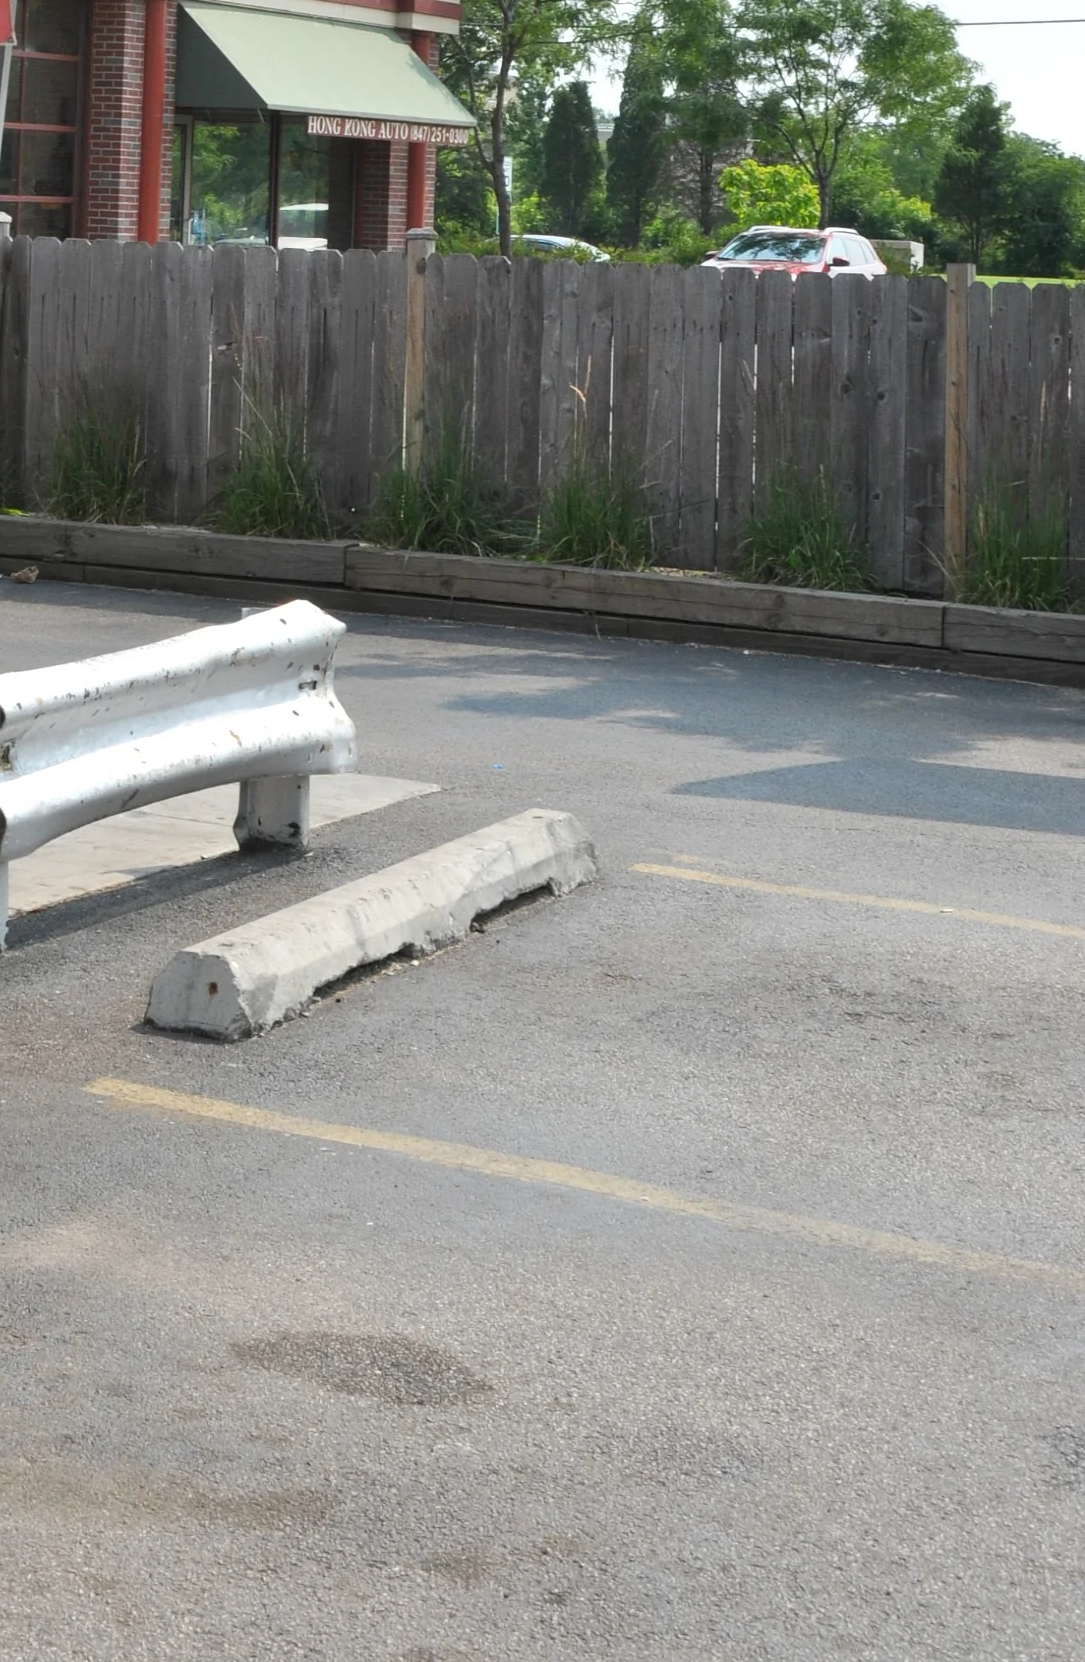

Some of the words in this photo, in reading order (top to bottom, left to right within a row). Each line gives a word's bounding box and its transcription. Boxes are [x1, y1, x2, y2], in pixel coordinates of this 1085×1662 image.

[307, 116, 342, 135] HONG
[344, 119, 376, 138] KONG
[379, 122, 409, 140] AUTO
